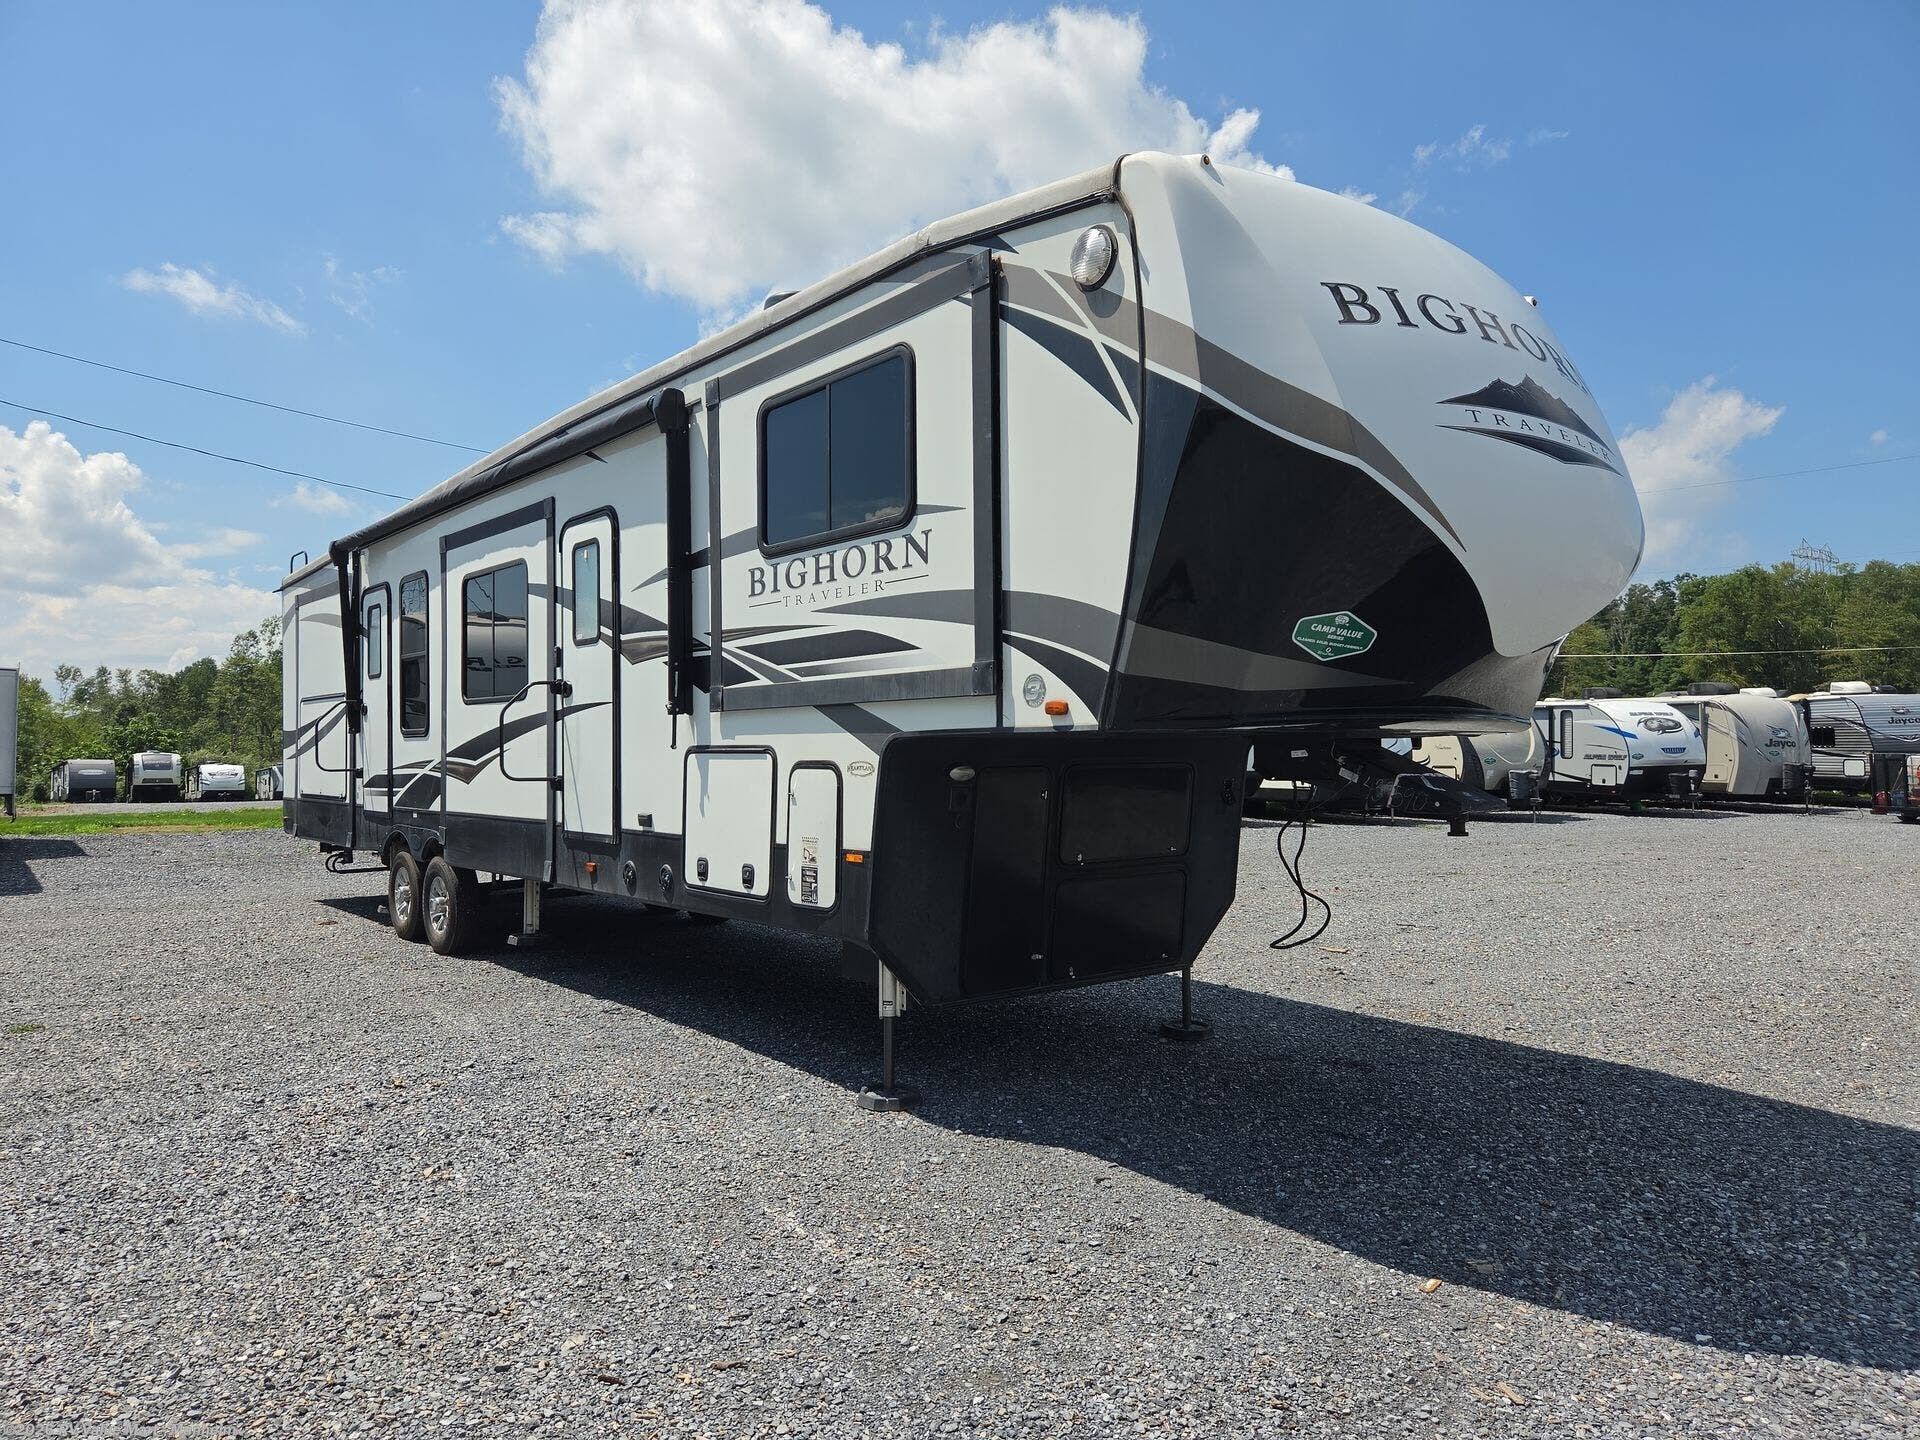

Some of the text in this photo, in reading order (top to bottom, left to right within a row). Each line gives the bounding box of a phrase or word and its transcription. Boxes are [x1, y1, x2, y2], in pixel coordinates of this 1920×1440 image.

[1320, 281, 1588, 396] BIGHORN
[1465, 409, 1614, 464] TRAVELER
[748, 528, 932, 598] BIGHORN
[782, 579, 884, 607] TRAVELER
[1311, 623, 1364, 639] CAMP VALUE
[1888, 717, 1920, 725] Jayco
[1765, 738, 1797, 749] Jayco
